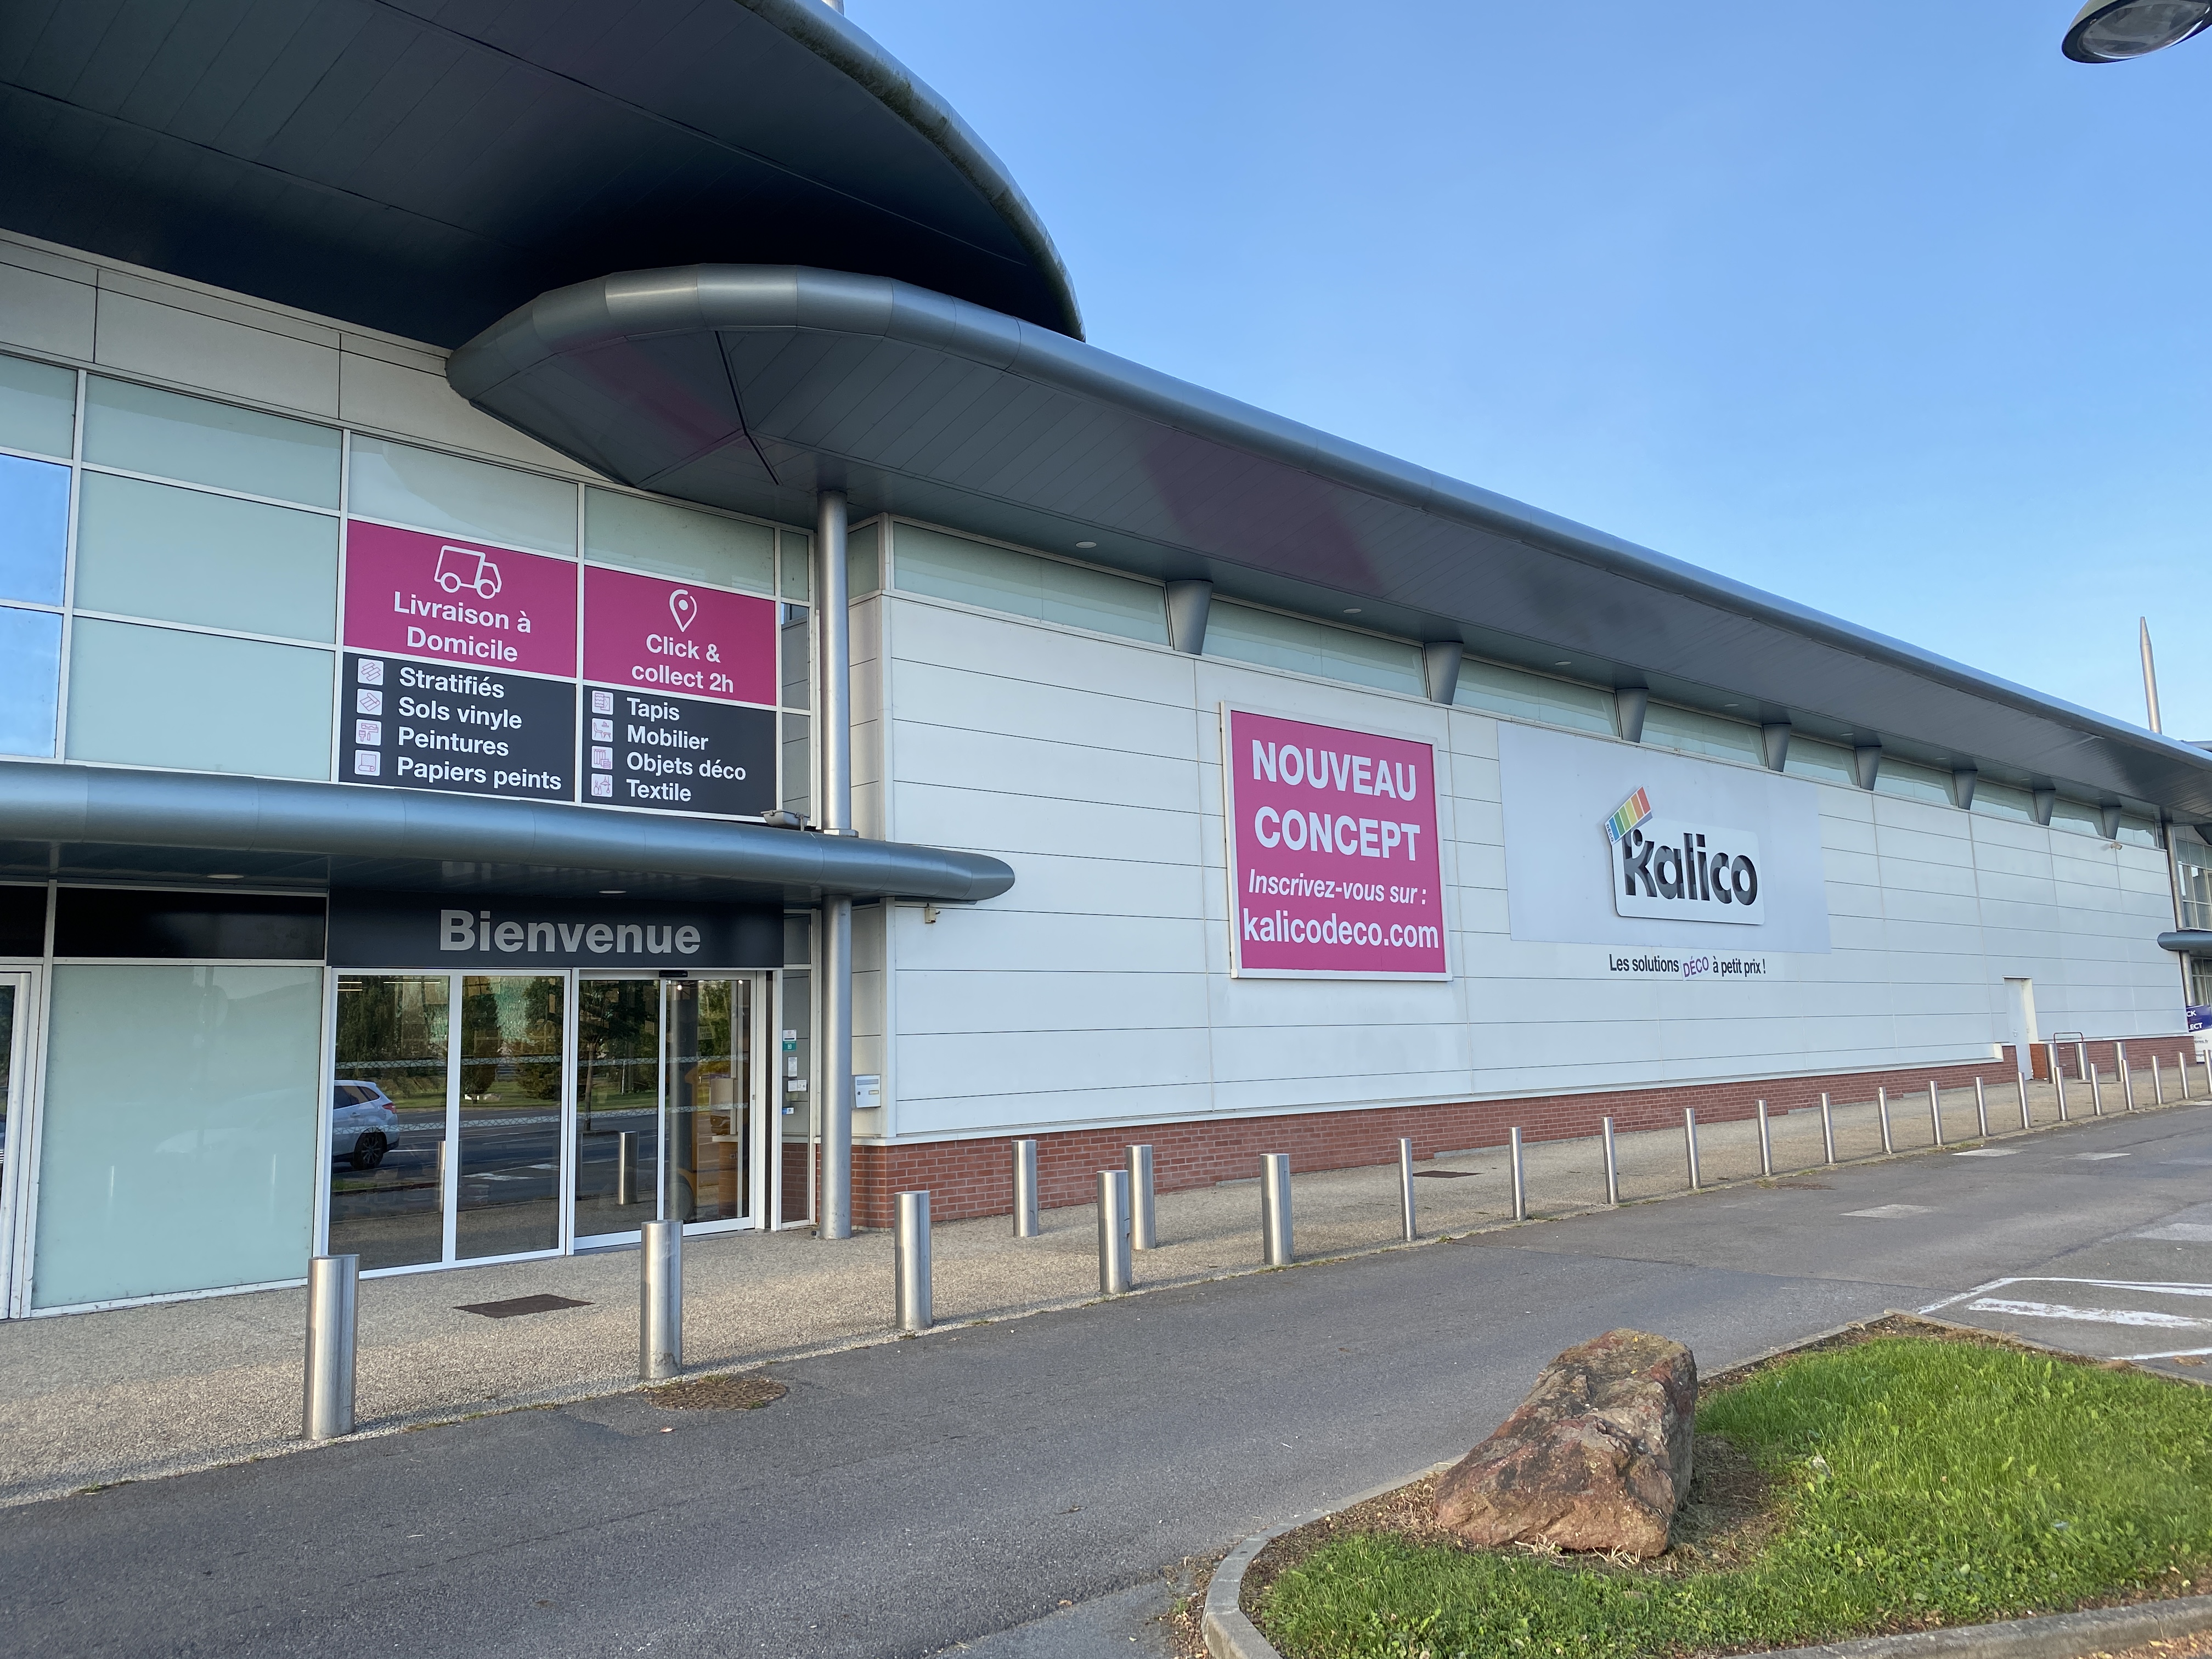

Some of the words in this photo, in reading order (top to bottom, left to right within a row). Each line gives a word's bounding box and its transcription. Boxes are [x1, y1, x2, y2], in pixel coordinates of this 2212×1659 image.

[394, 591, 509, 630] Livraison
[517, 610, 531, 634] à
[407, 626, 518, 662] Domicile
[646, 634, 699, 660] Click
[706, 644, 721, 663] &
[399, 667, 504, 698] Stratifiés
[631, 664, 704, 689] collect
[709, 673, 733, 693] 2h
[398, 696, 450, 721] Sols
[456, 705, 522, 731] vinyle
[627, 697, 680, 722] Tapis
[398, 726, 509, 757] Peintures
[627, 724, 709, 751] Mobilier
[397, 756, 487, 783] Papiers
[493, 768, 561, 790] peints
[627, 752, 693, 778] Objets
[699, 759, 746, 780] déco
[1252, 739, 1417, 801] NOUVEAU
[626, 778, 691, 802] Textile
[1254, 806, 1420, 861] CONCEPT
[1249, 868, 1385, 902] Inscrivez-vous
[1390, 885, 1418, 904] sur
[439, 909, 701, 954] Bienvenue
[1243, 908, 1438, 949] kalicodeco.com
[1609, 953, 1630, 972] Les
[1632, 955, 1679, 973] solutions
[1683, 956, 1709, 978] DÉCO
[1713, 956, 1719, 973] à
[1721, 957, 1742, 977] petit
[1744, 957, 1761, 978] prix
